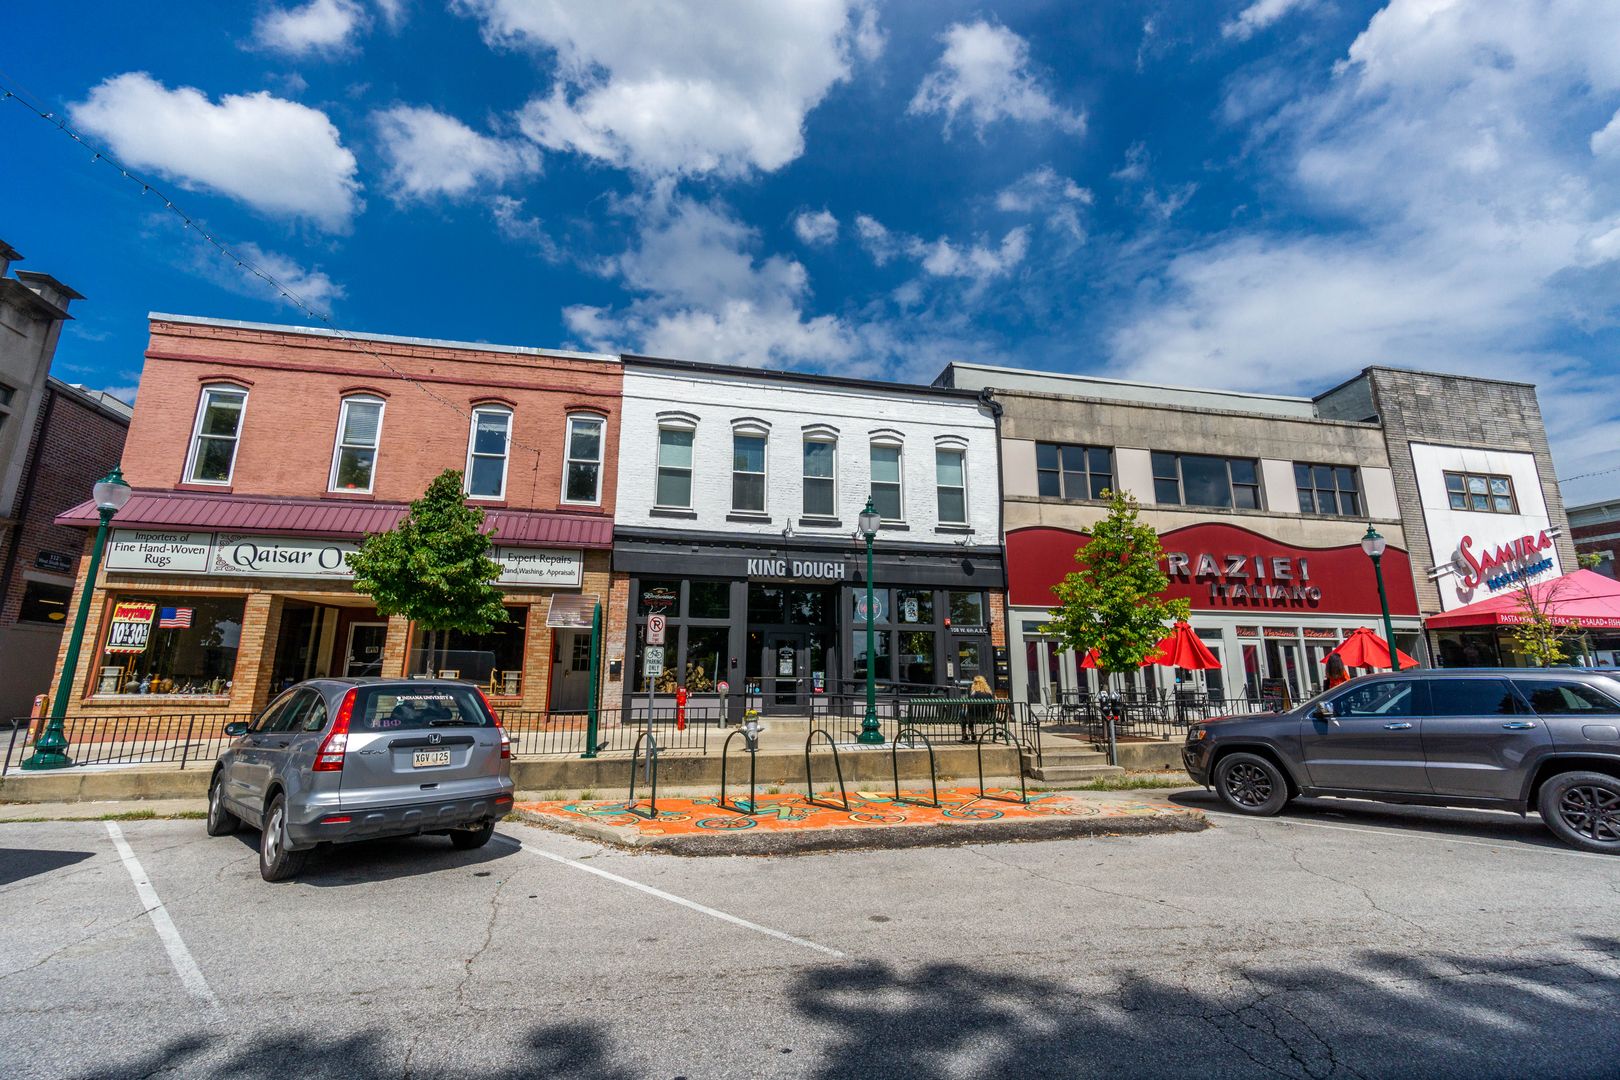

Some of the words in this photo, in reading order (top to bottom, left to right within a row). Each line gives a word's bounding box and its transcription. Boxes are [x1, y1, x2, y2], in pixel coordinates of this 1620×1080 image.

[135, 532, 177, 542] Importers
[180, 533, 191, 542] of
[114, 543, 136, 552] Fine
[139, 543, 205, 554] Hand-Woven
[144, 553, 171, 567] Rugs
[233, 543, 313, 570] Qaisar
[507, 553, 536, 565] Expert
[539, 554, 572, 566] Repairs
[1460, 530, 1552, 588] SAMIRA
[747, 559, 786, 576] KING
[793, 561, 845, 578] DOUGH
[1150, 552, 1310, 580] RAZIE!
[546, 569, 576, 577] Appraisals
[1210, 584, 1321, 600] ITALIANO
[1500, 614, 1518, 622] PASTA
[1549, 616, 1566, 624] STEAK
[1585, 618, 1604, 626] SALAD
[415, 753, 430, 763] XGV
[435, 752, 449, 762] 125
